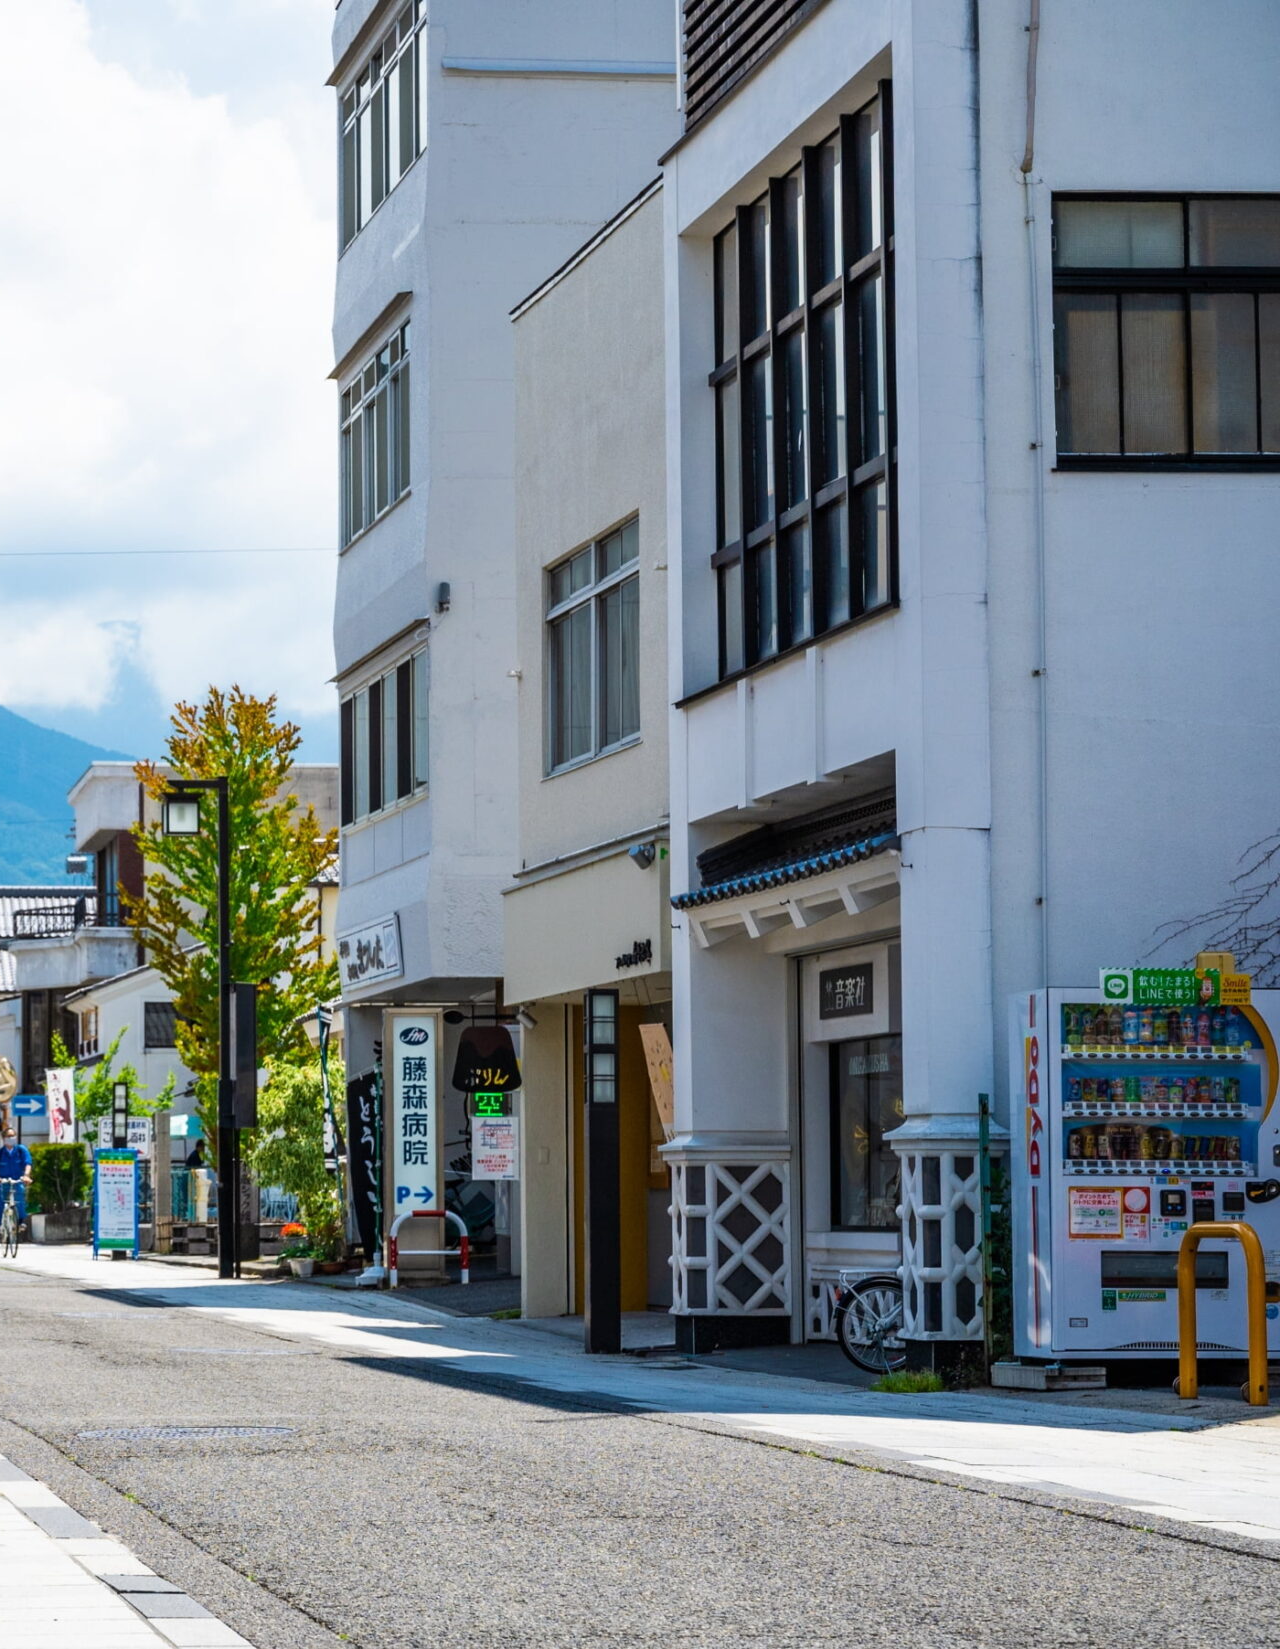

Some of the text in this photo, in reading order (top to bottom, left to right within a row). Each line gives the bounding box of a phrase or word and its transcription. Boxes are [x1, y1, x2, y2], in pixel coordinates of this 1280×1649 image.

[1223, 977, 1248, 988] Smile
[835, 976, 865, 1010] 音楽社
[1139, 989, 1195, 999] LINEで使う!
[402, 1056, 428, 1166] 藤森病院
[475, 1093, 503, 1116] 空
[396, 1186, 410, 1204] P
